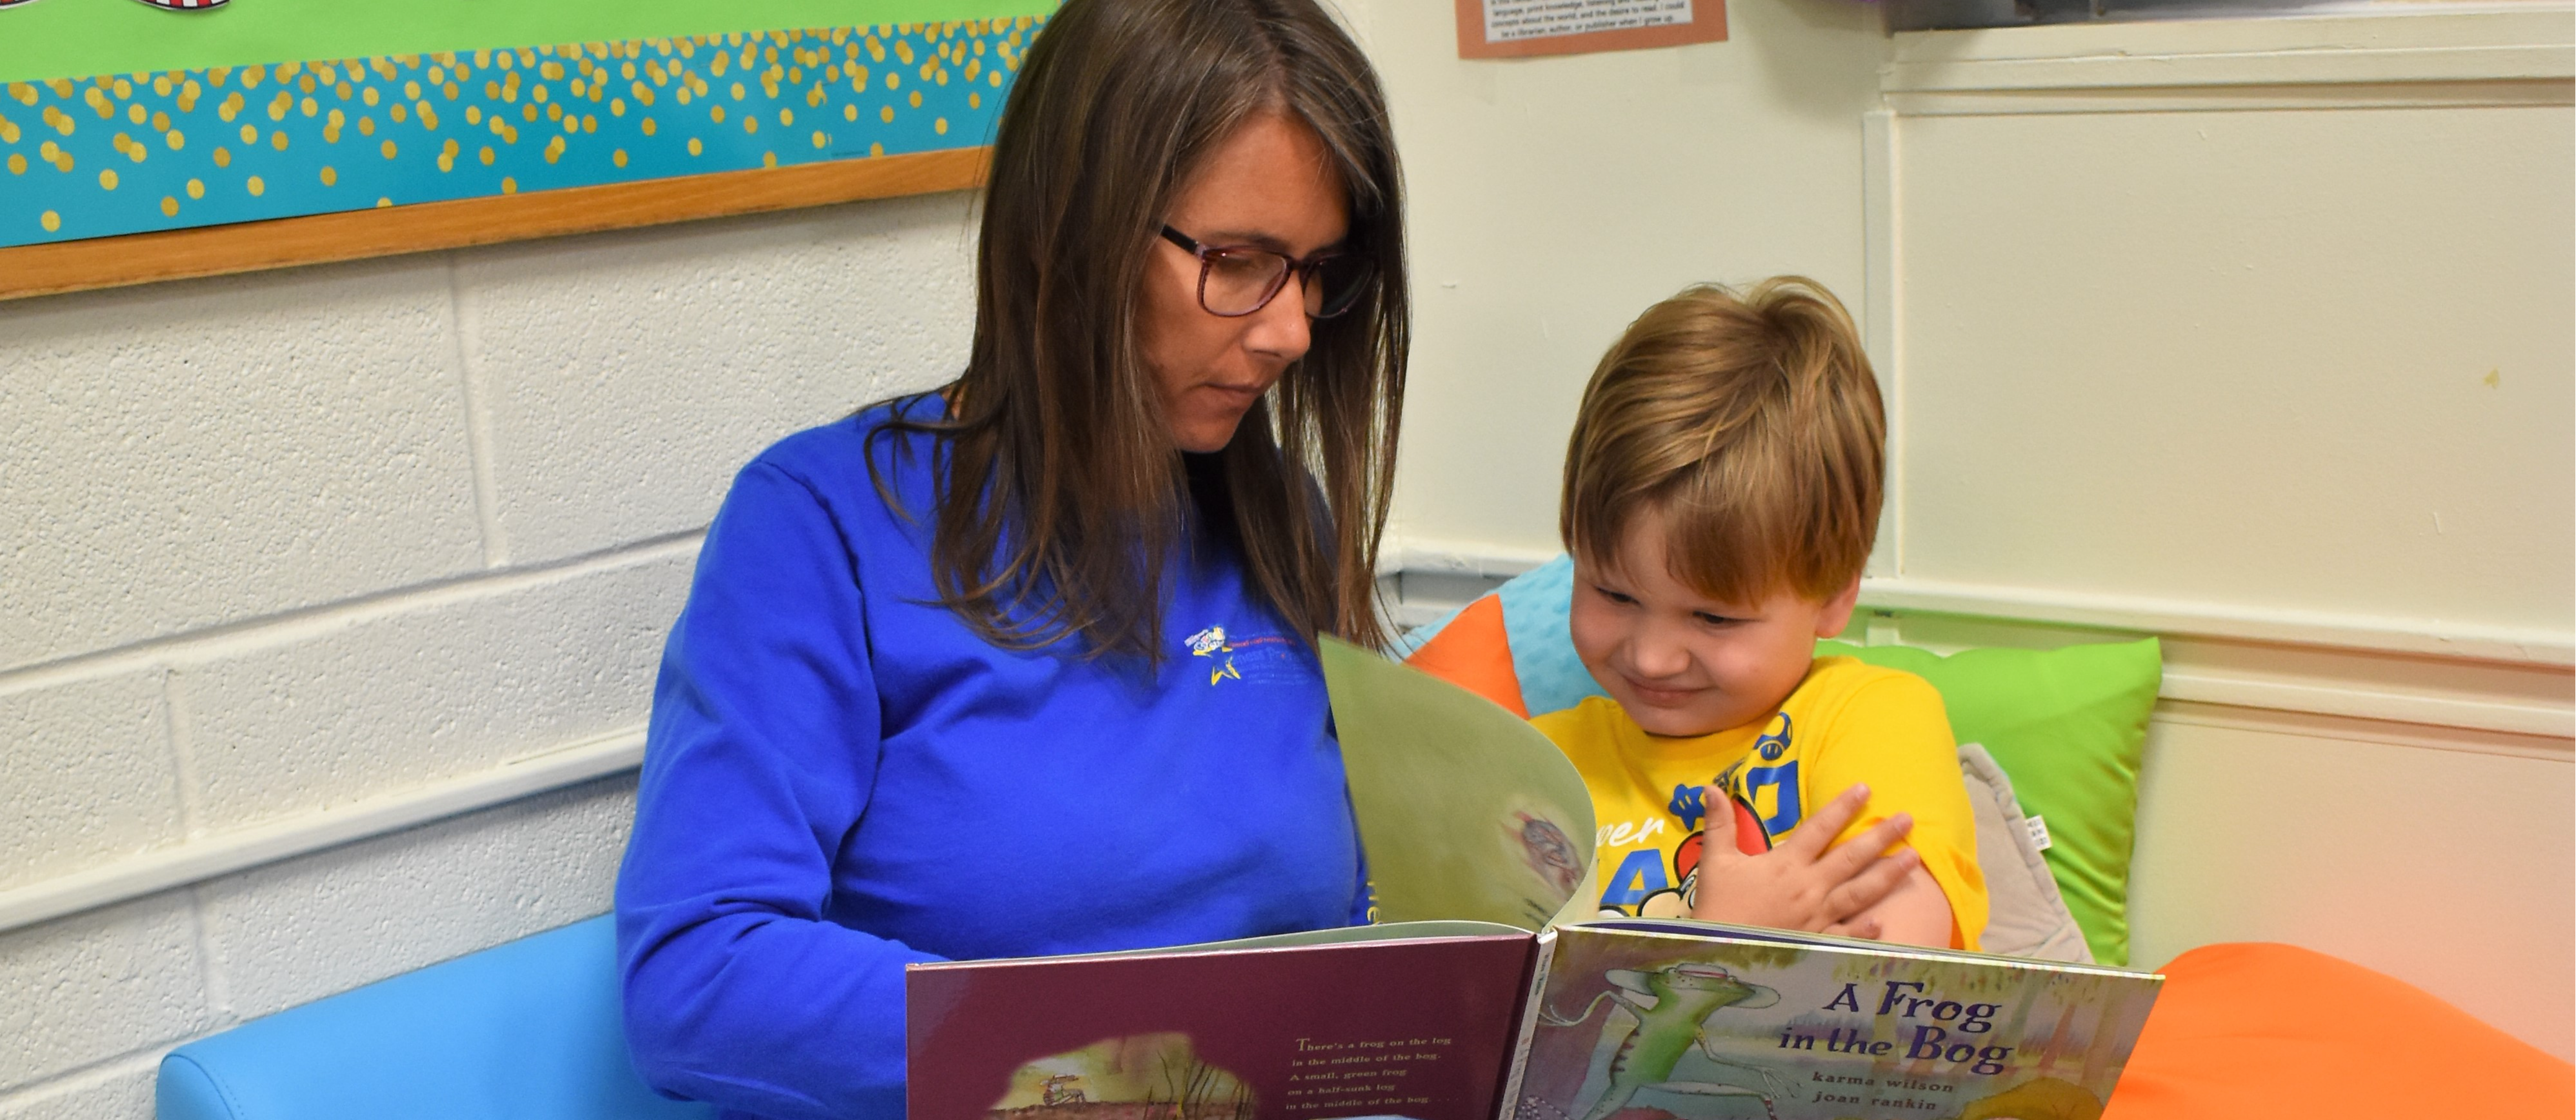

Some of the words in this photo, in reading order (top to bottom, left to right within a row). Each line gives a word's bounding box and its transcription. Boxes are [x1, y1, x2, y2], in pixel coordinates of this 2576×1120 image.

[1644, 16, 1661, 25] grow
[1822, 983, 1859, 1012] A
[1876, 981, 2002, 1034] Frog
[1296, 1038, 1343, 1052] There's
[1779, 1027, 1814, 1050] in
[1827, 1028, 1892, 1056] the
[1906, 1025, 2015, 1075] Bog
[1331, 1055, 1371, 1065] middle
[1304, 1072, 1339, 1081] small,
[1382, 1068, 1407, 1077] frog
[1318, 1085, 1372, 1094] half-sunk
[1376, 1083, 1395, 1092] log
[1813, 1072, 1875, 1086] karma
[1886, 1079, 1954, 1093] wilson
[1324, 1099, 1363, 1108] middle
[1812, 1092, 1861, 1104] joan
[1872, 1097, 1936, 1110] rankin
